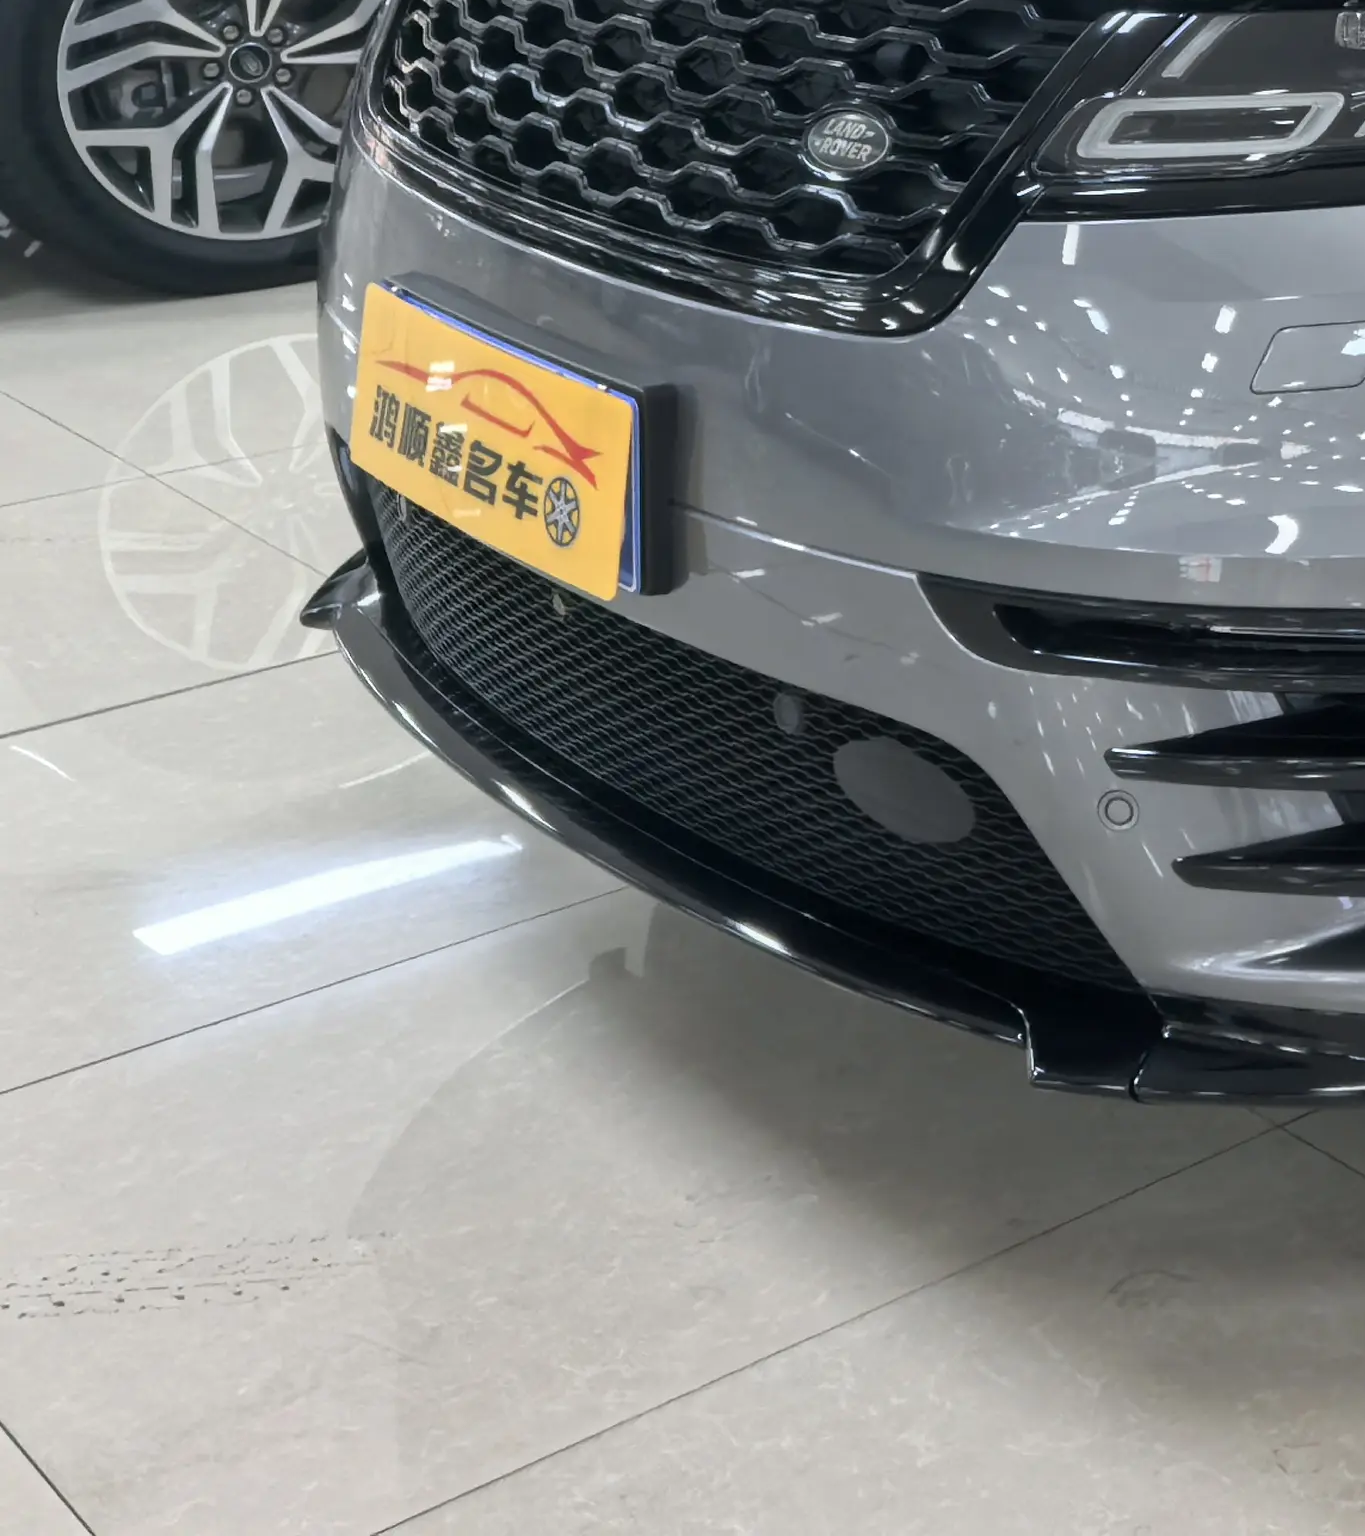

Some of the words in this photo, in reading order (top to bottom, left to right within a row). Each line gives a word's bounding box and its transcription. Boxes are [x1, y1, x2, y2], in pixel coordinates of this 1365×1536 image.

[823, 118, 867, 139] LAND
[819, 137, 872, 162] ROVER
[369, 384, 544, 521] 鸿顺鑫名车
